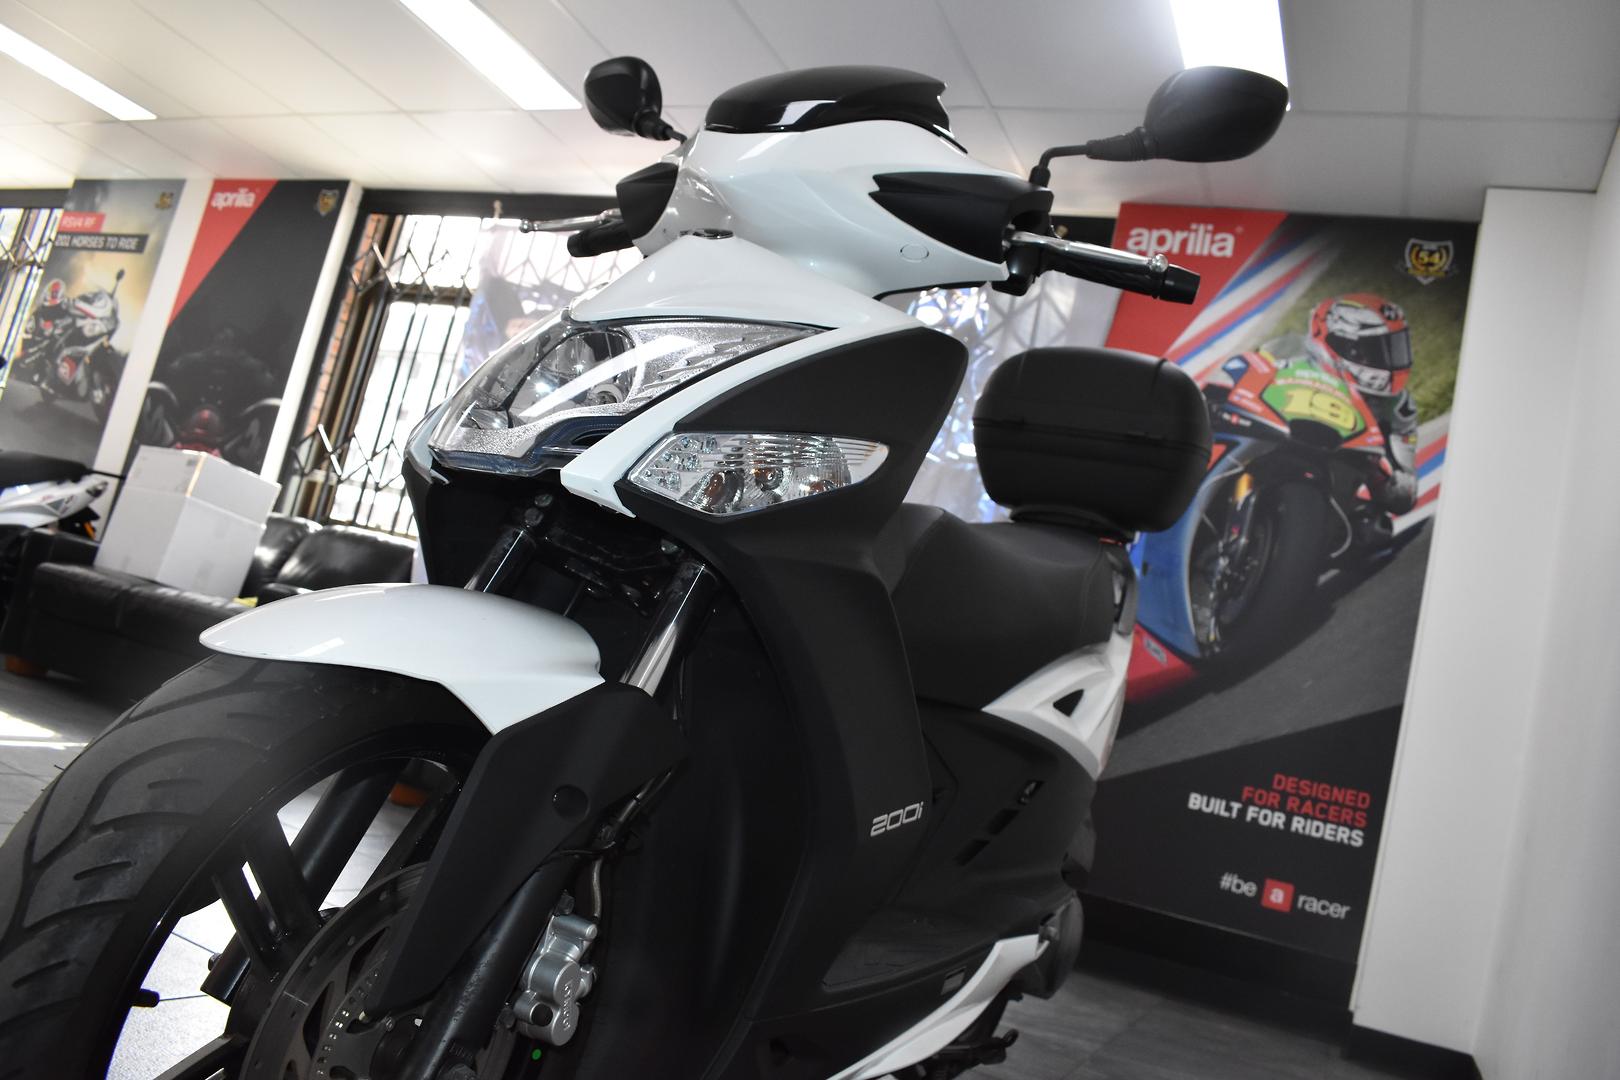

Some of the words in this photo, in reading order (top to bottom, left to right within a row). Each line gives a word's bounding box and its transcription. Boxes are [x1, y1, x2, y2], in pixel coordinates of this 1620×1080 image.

[211, 187, 256, 212] aprilia
[72, 235, 105, 249] HORSES
[106, 237, 118, 249] TO
[118, 238, 139, 250] RIDE
[1126, 222, 1235, 258] aprilia
[1241, 786, 1280, 808] FOR
[1286, 796, 1367, 828] RACERS
[1272, 773, 1370, 809] DESIGNED
[870, 801, 924, 837] 200i
[1188, 792, 1242, 819] BUILT
[1246, 805, 1286, 830] FOR
[1290, 816, 1364, 847] RIDERS
[1219, 872, 1257, 897] #be
[1269, 887, 1285, 904] a
[1297, 894, 1351, 919] racer
